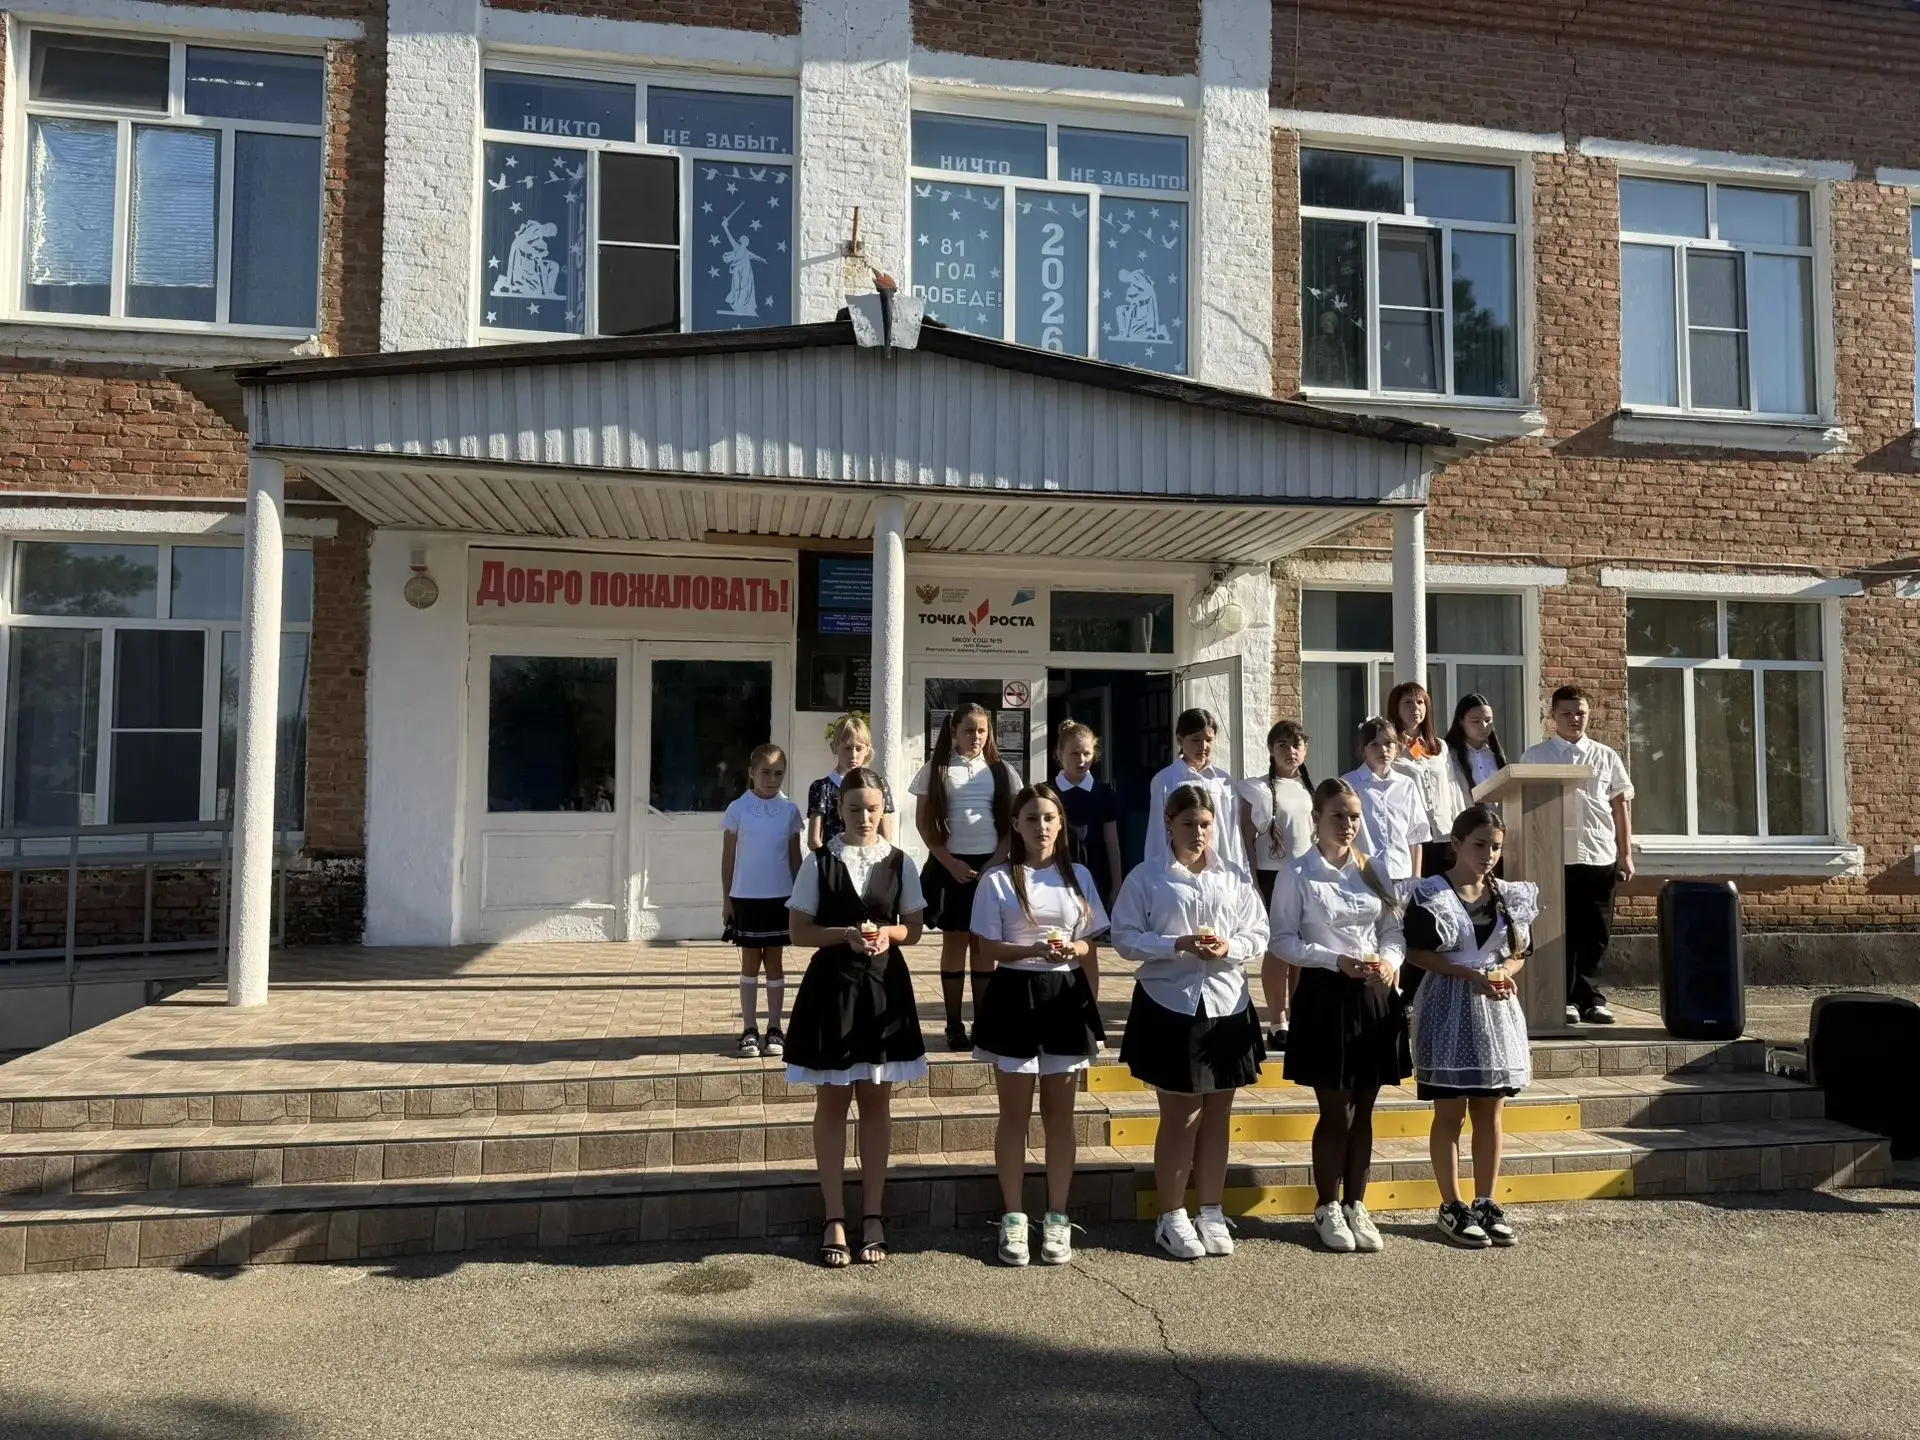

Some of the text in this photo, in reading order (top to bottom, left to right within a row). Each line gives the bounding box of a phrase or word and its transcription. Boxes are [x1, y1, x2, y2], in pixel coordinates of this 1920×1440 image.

[523, 115, 600, 137] НИКТО
[663, 129, 691, 145] НЕ
[940, 155, 1186, 190] НИЧТО НЕ ЗАБЫТО!
[940, 238, 965, 257] 81
[935, 262, 976, 280] ГОД
[913, 285, 1002, 307] ПОБЕДЕ!
[1041, 223, 1064, 351] 2026
[590, 571, 789, 613] ПОЖАЛОВАТЬ!
[918, 613, 1035, 627] ТОЧКА РОСТА
